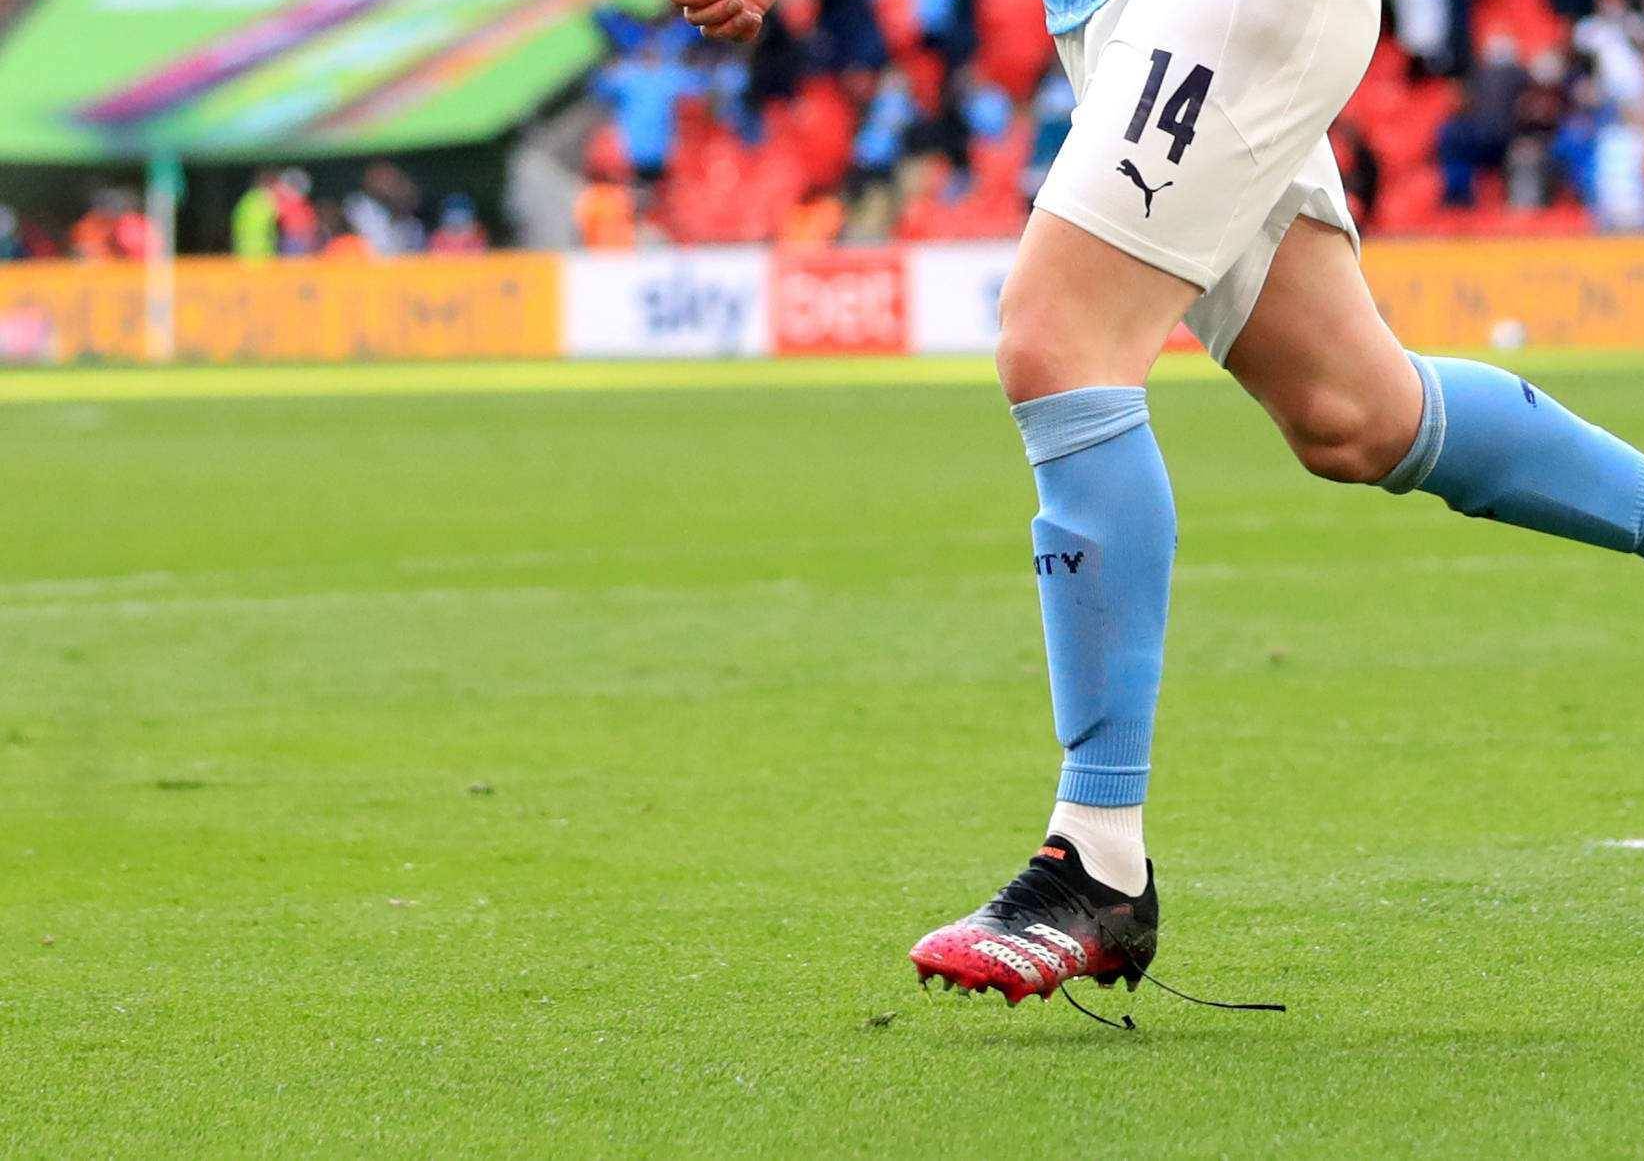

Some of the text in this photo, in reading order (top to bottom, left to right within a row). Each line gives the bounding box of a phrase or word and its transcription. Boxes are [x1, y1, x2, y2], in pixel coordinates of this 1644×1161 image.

[1124, 48, 1214, 165] 14
[634, 250, 752, 352] sky
[782, 268, 905, 343] bet
